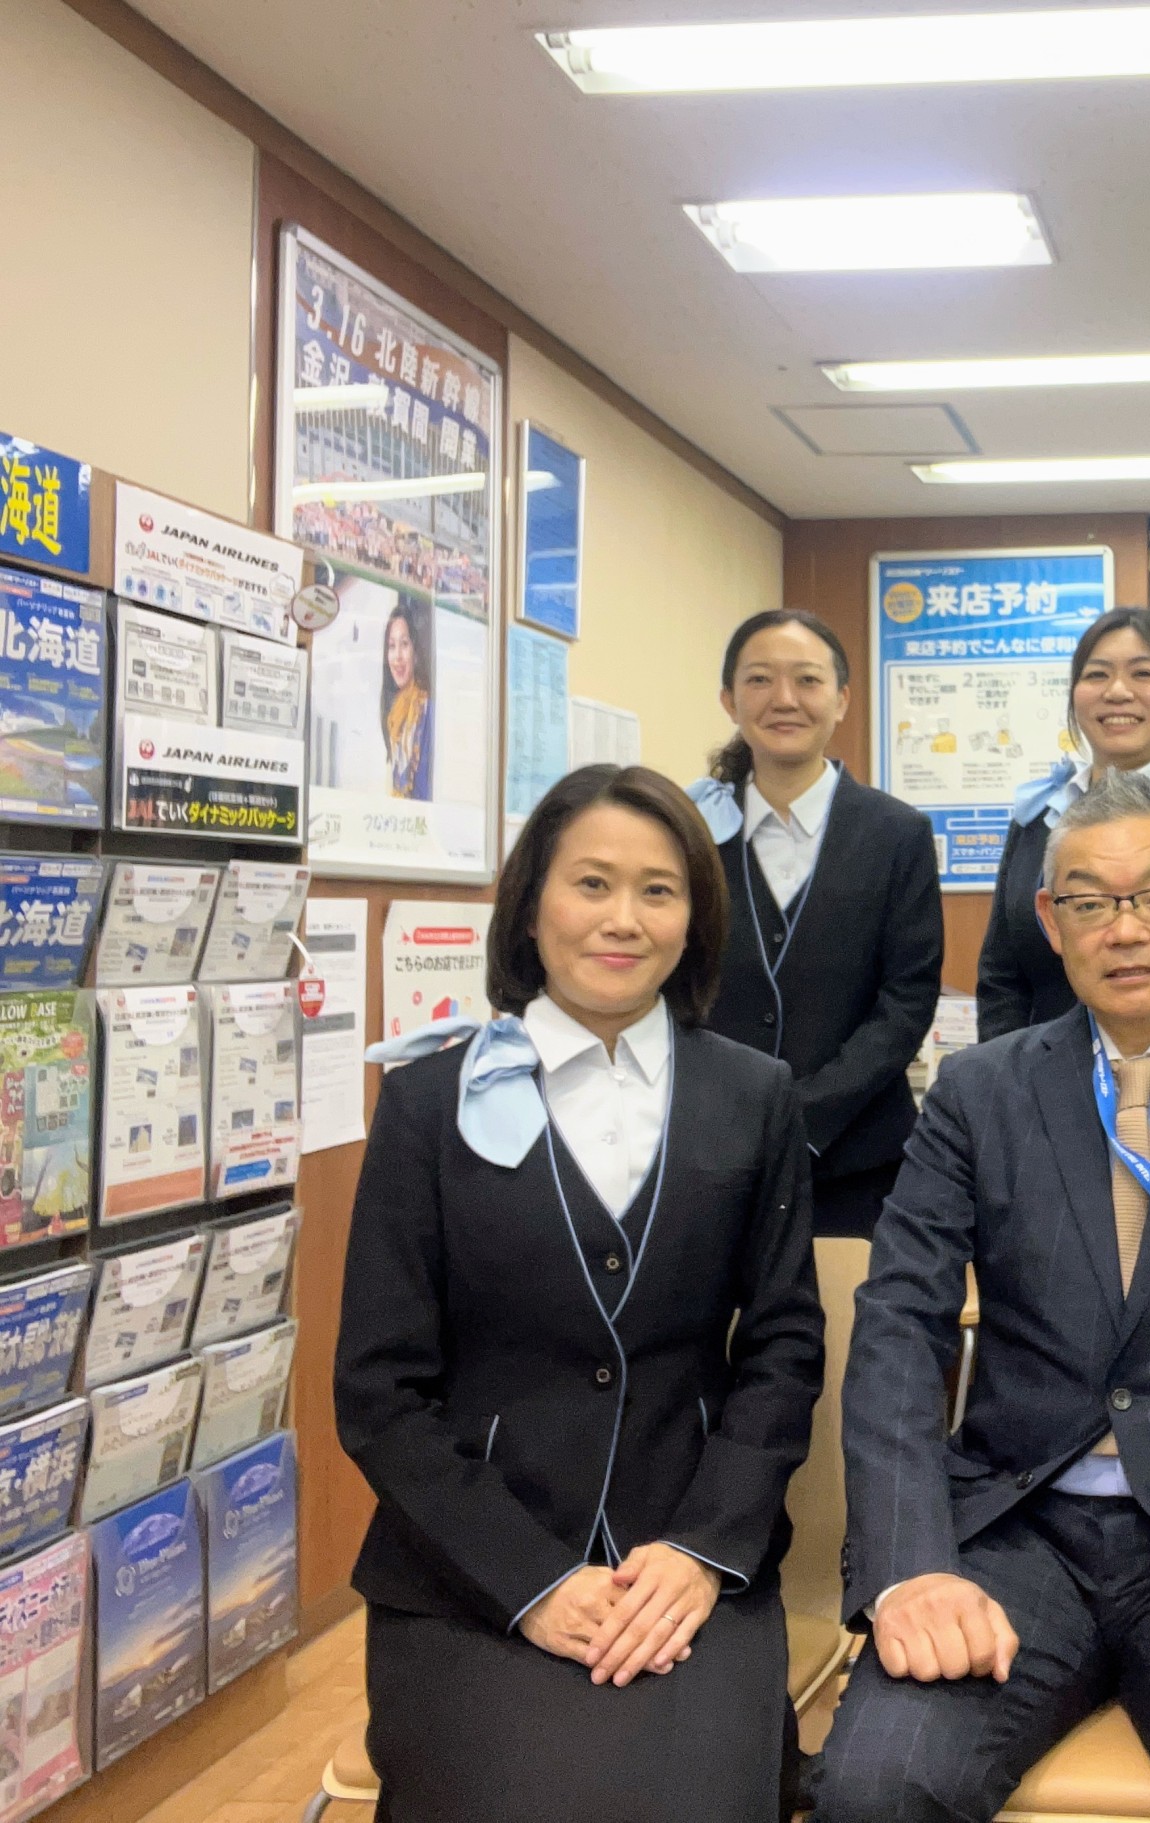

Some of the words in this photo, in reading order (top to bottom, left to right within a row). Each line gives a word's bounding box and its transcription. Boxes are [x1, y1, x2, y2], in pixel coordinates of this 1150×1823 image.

[161, 525, 210, 549] JAPAN
[211, 543, 280, 573] AIRLINES
[926, 580, 1058, 618] 来店予約
[162, 746, 214, 765] JAPAN
[216, 755, 289, 773] AIRLINES
